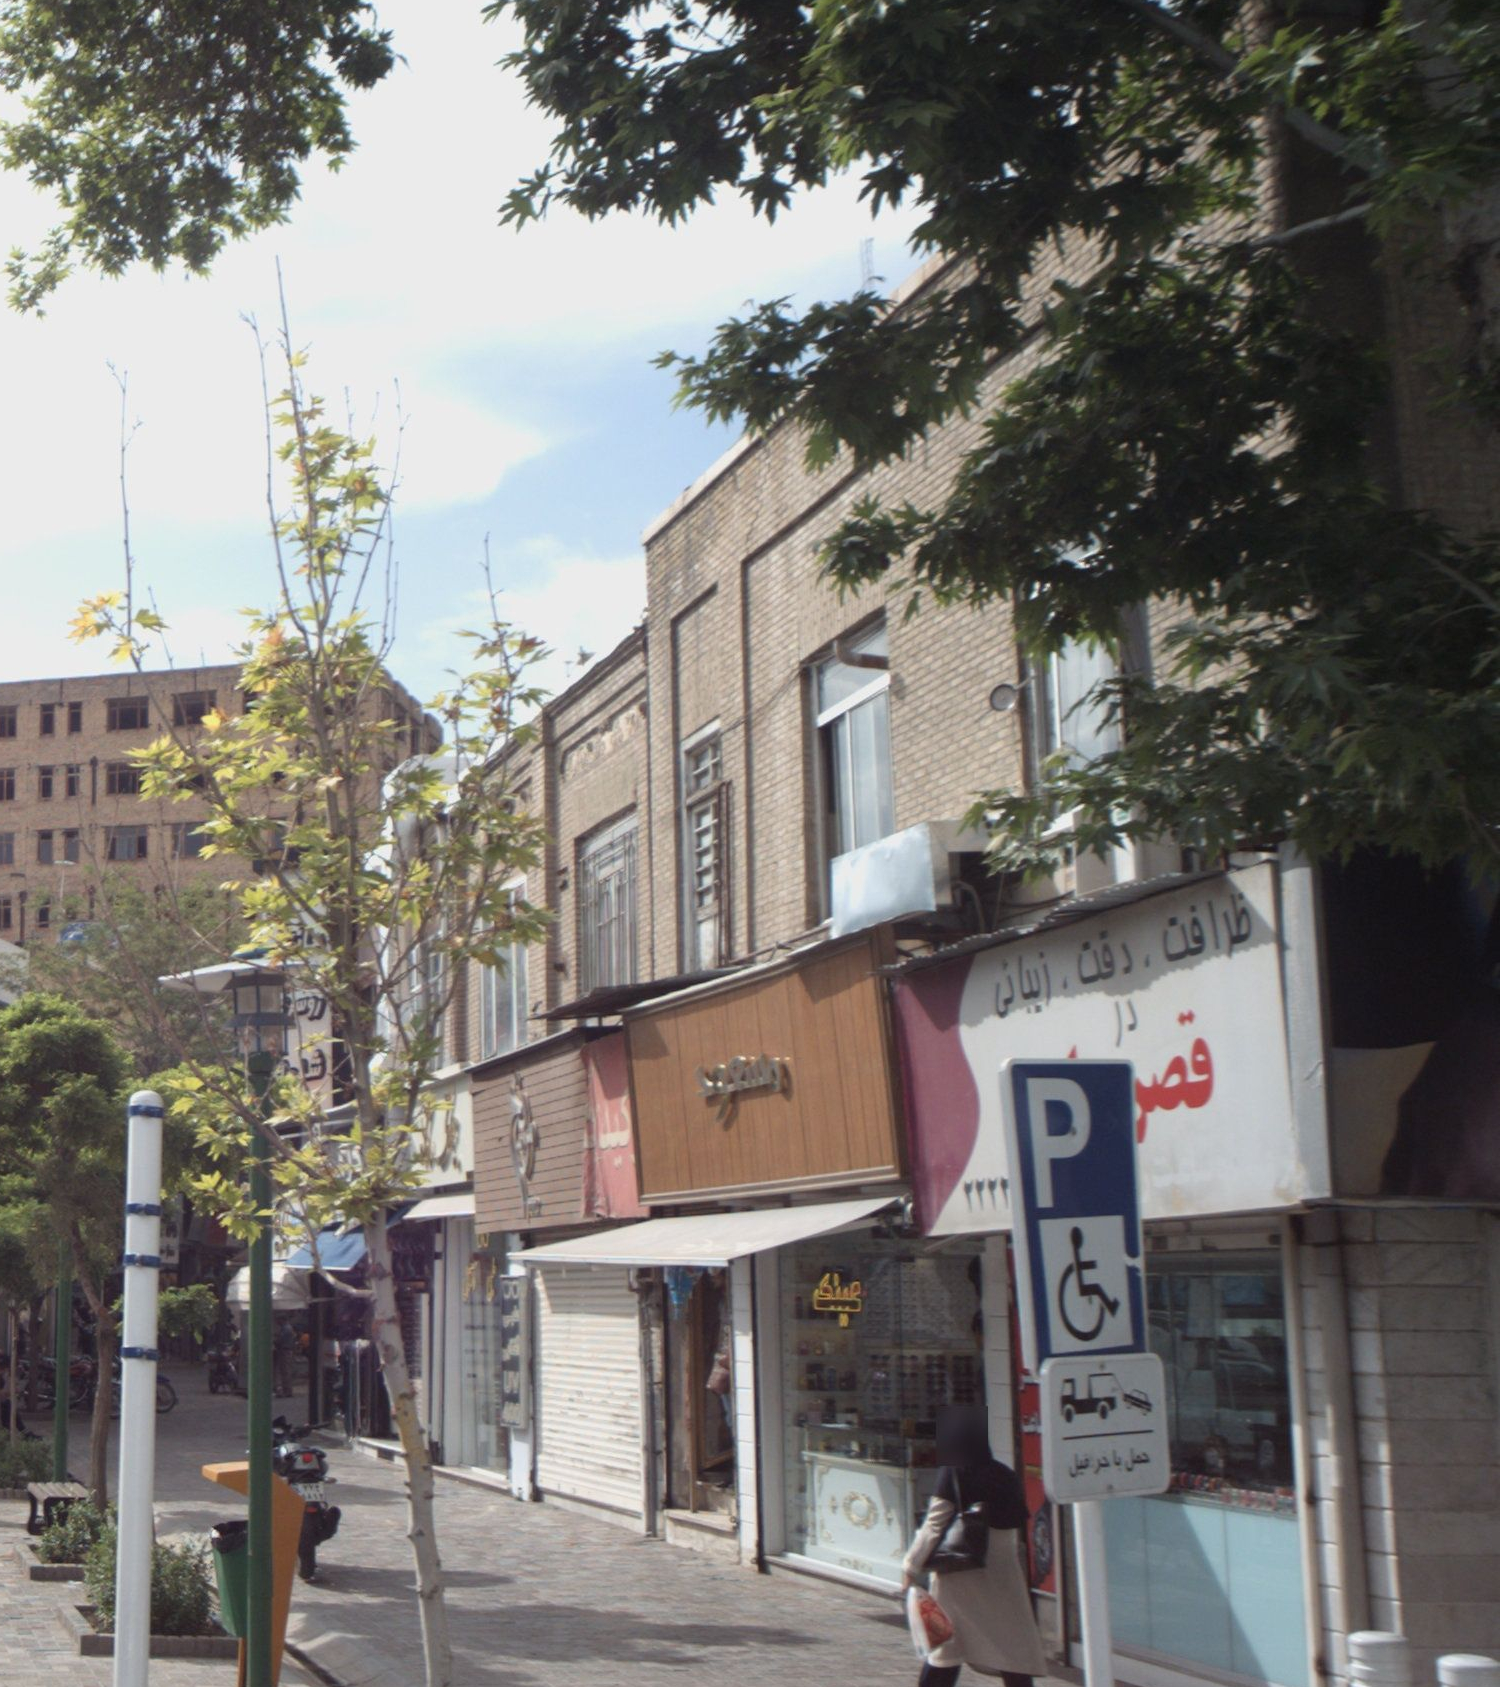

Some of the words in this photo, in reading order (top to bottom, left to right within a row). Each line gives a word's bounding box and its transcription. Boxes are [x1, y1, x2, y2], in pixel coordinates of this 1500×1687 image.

[1164, 892, 1252, 961] ظرافت
[1078, 930, 1133, 984] دقت
[1114, 999, 1138, 1047] در
[1026, 1077, 1091, 1208] P
[1125, 1447, 1151, 1472] حمل
